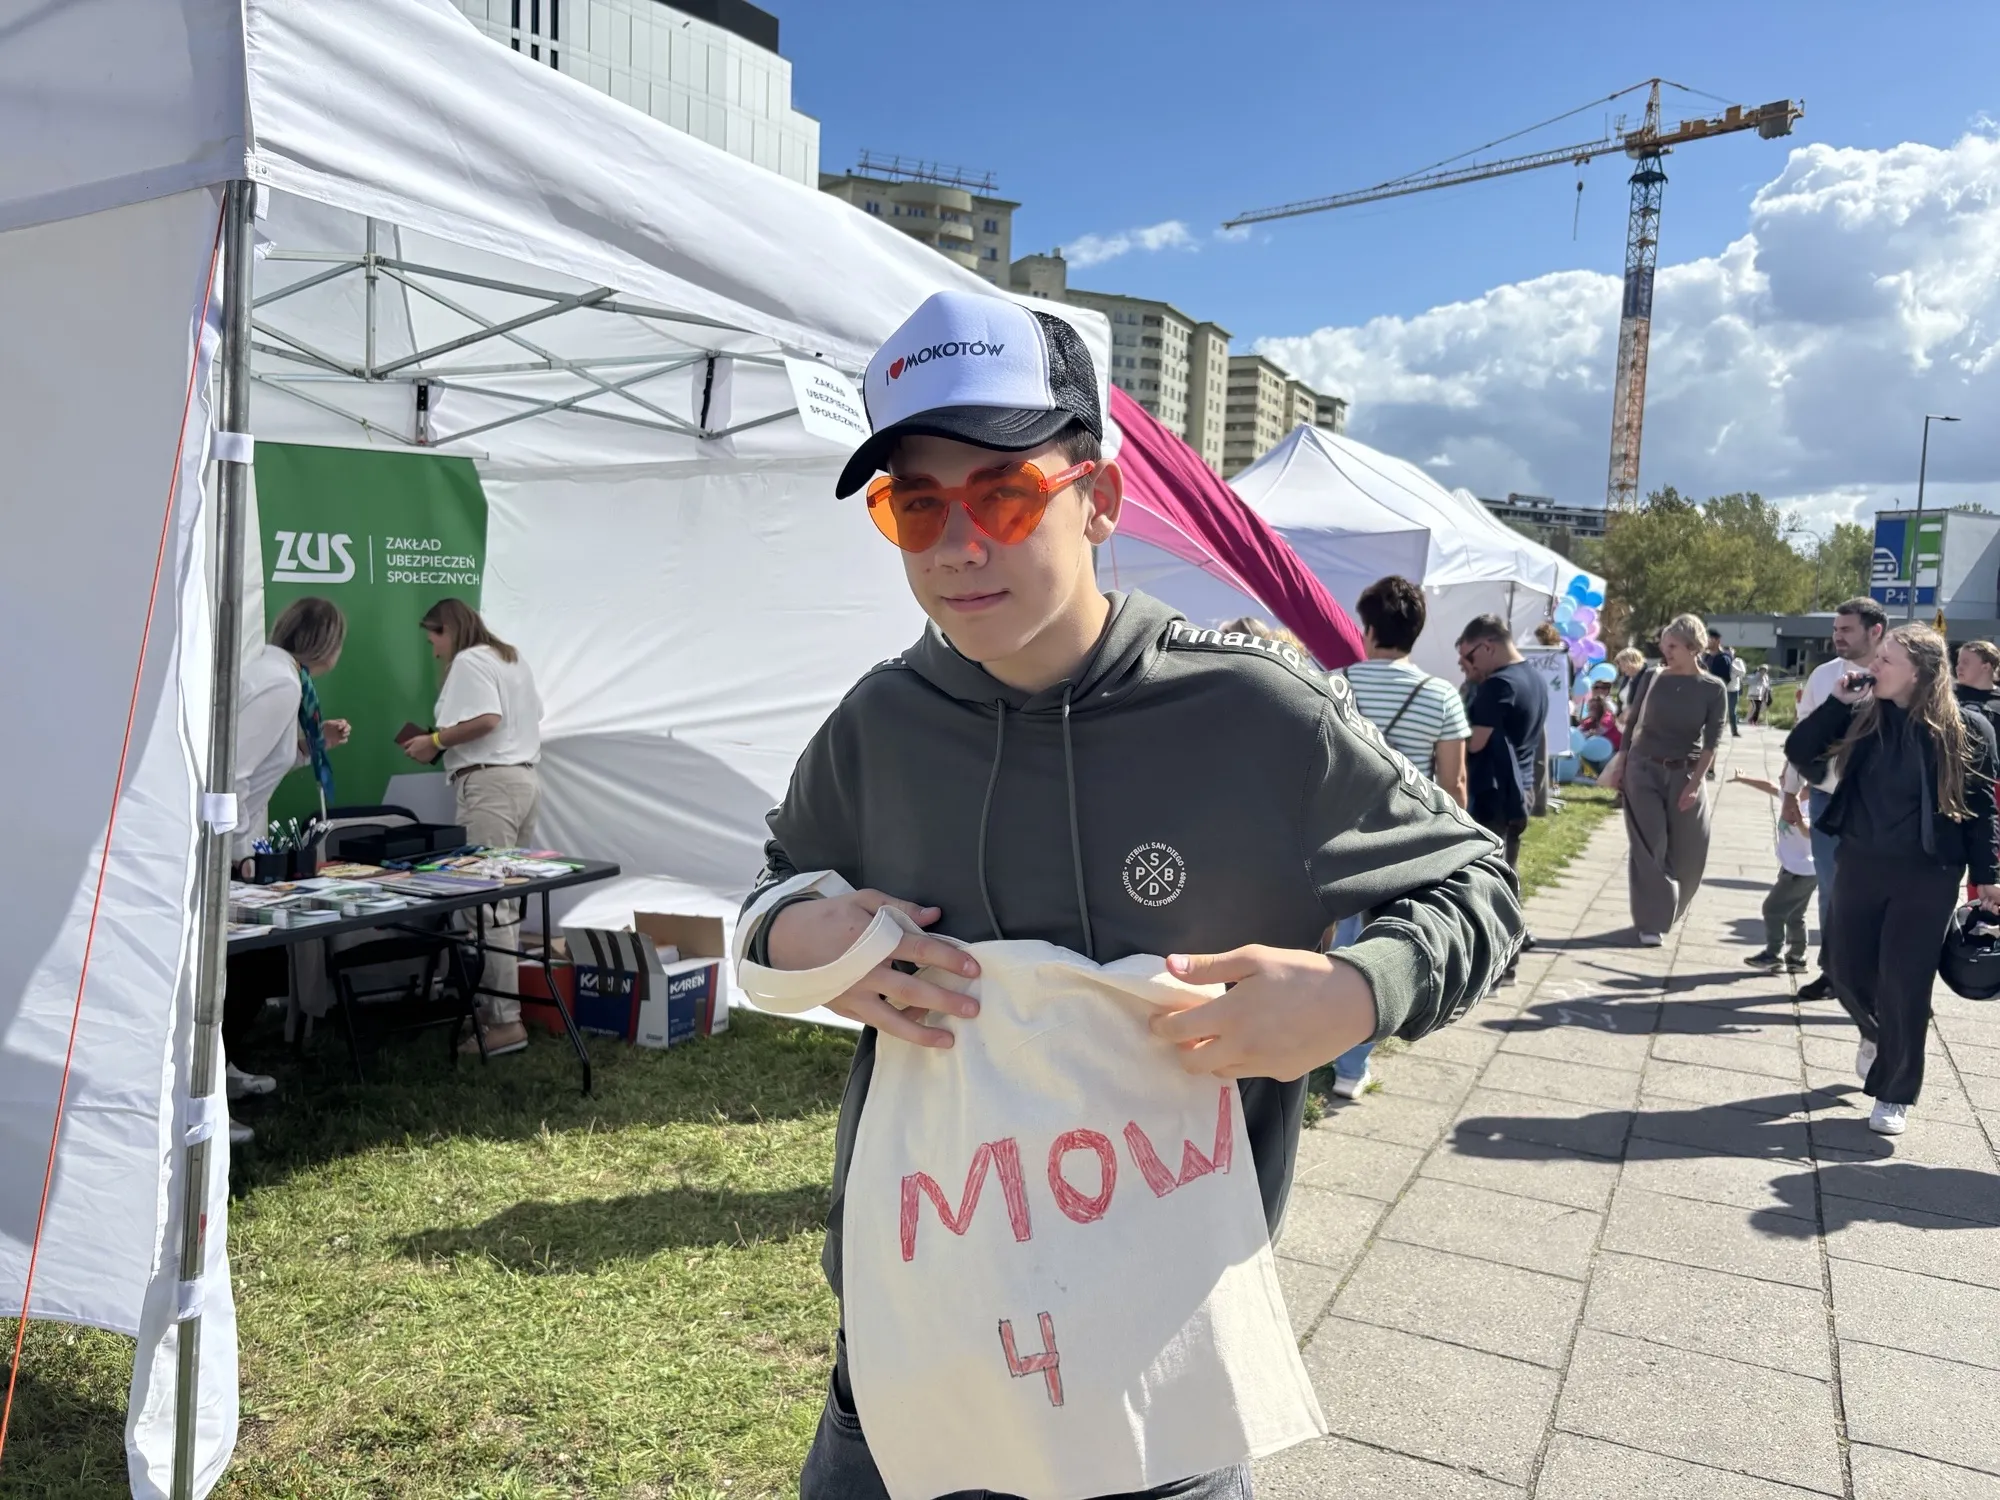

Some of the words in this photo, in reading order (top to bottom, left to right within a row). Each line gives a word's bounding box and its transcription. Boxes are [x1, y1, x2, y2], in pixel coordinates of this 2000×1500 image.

[904, 340, 1005, 372] MOKOTÓW
[385, 536, 442, 551] ZAKŁAD
[271, 530, 356, 584] ZUS
[386, 553, 475, 569] UBEZPIECZEŃ
[386, 571, 480, 585] SPOŁECZNYCH
[1125, 843, 1150, 865] PITBULL
[1151, 841, 1167, 851] SAN
[1166, 846, 1185, 867] DIEGO
[1122, 871, 1144, 904] SOUTHERN
[1143, 888, 1182, 907] CALIFORNIA
[1177, 872, 1187, 889] 1989
[580, 973, 631, 994] KAN
[669, 974, 705, 995] KAREN
[900, 1086, 1233, 1262] MOW
[998, 1310, 1064, 1407] 4
